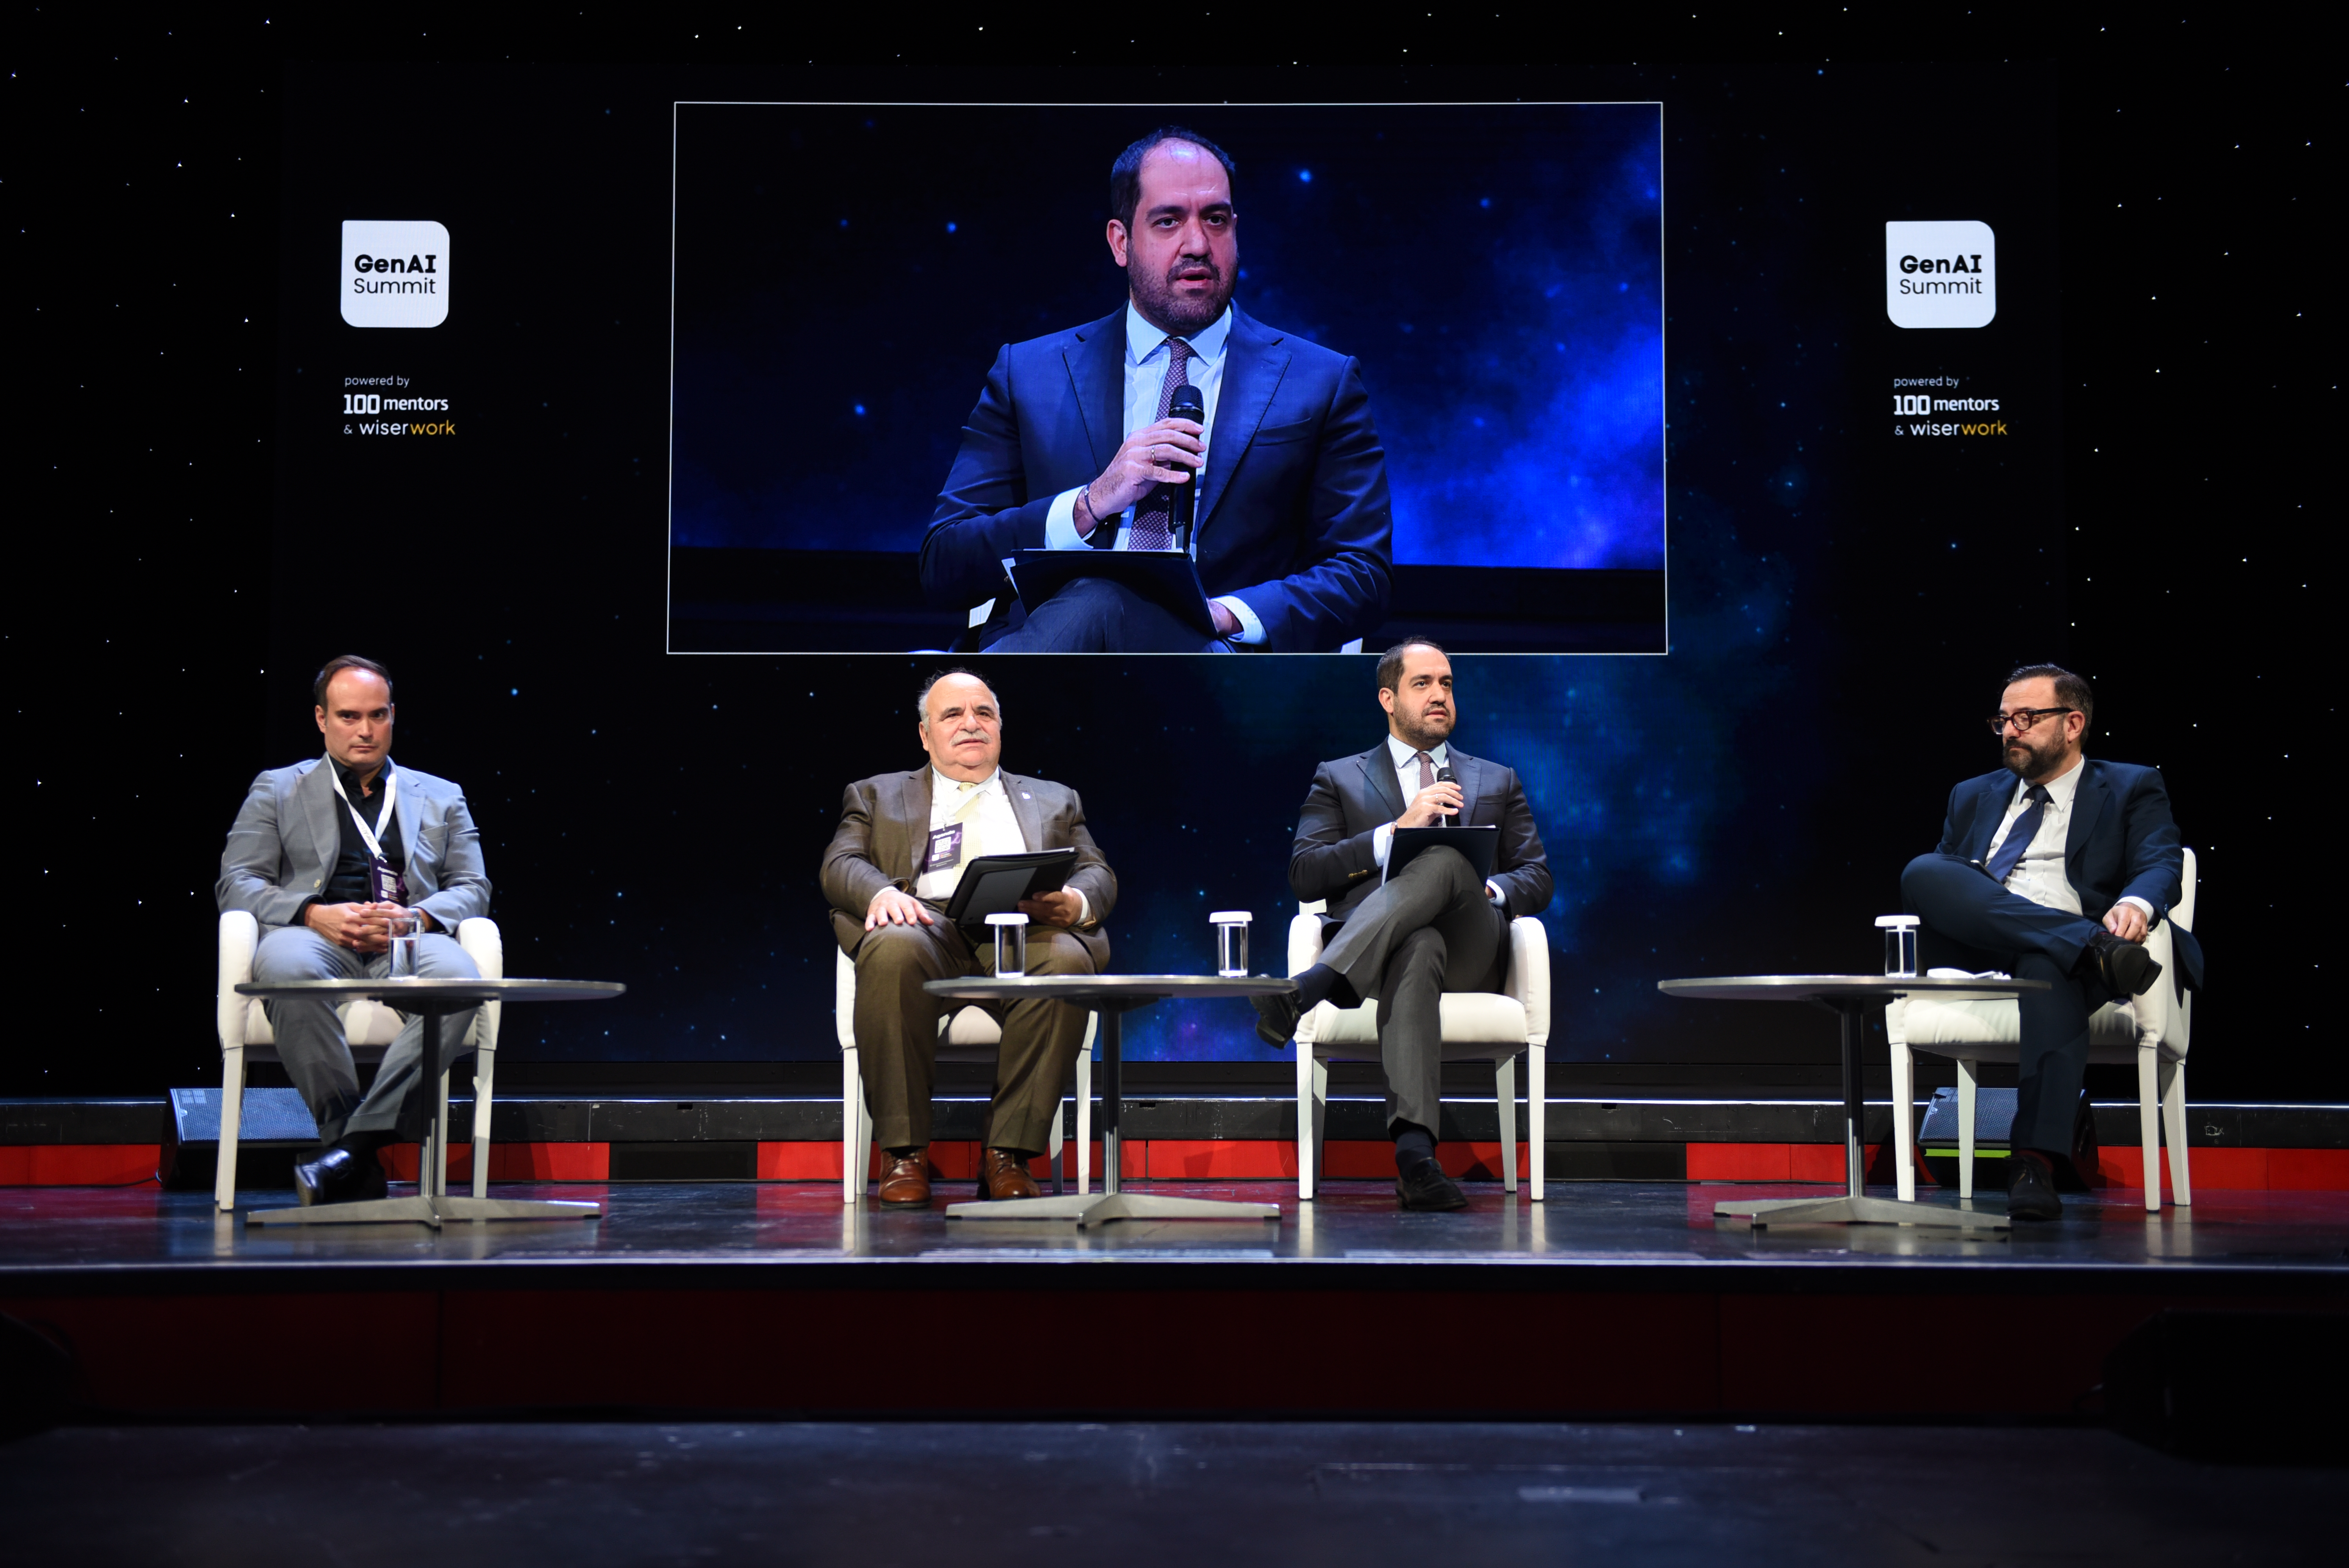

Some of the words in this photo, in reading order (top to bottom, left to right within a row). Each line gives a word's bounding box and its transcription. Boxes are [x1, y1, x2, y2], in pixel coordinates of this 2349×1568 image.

[355, 254, 437, 273] GenAI
[1900, 255, 1982, 274] GenAI
[354, 278, 436, 294] Summit
[1900, 278, 1982, 294] Summit
[345, 376, 393, 387] powered
[397, 376, 410, 388] by
[1894, 376, 1943, 388] powered
[1946, 376, 1959, 388] by
[344, 424, 352, 434] &
[1895, 425, 1903, 435] &
[932, 830, 955, 839] Agenda
